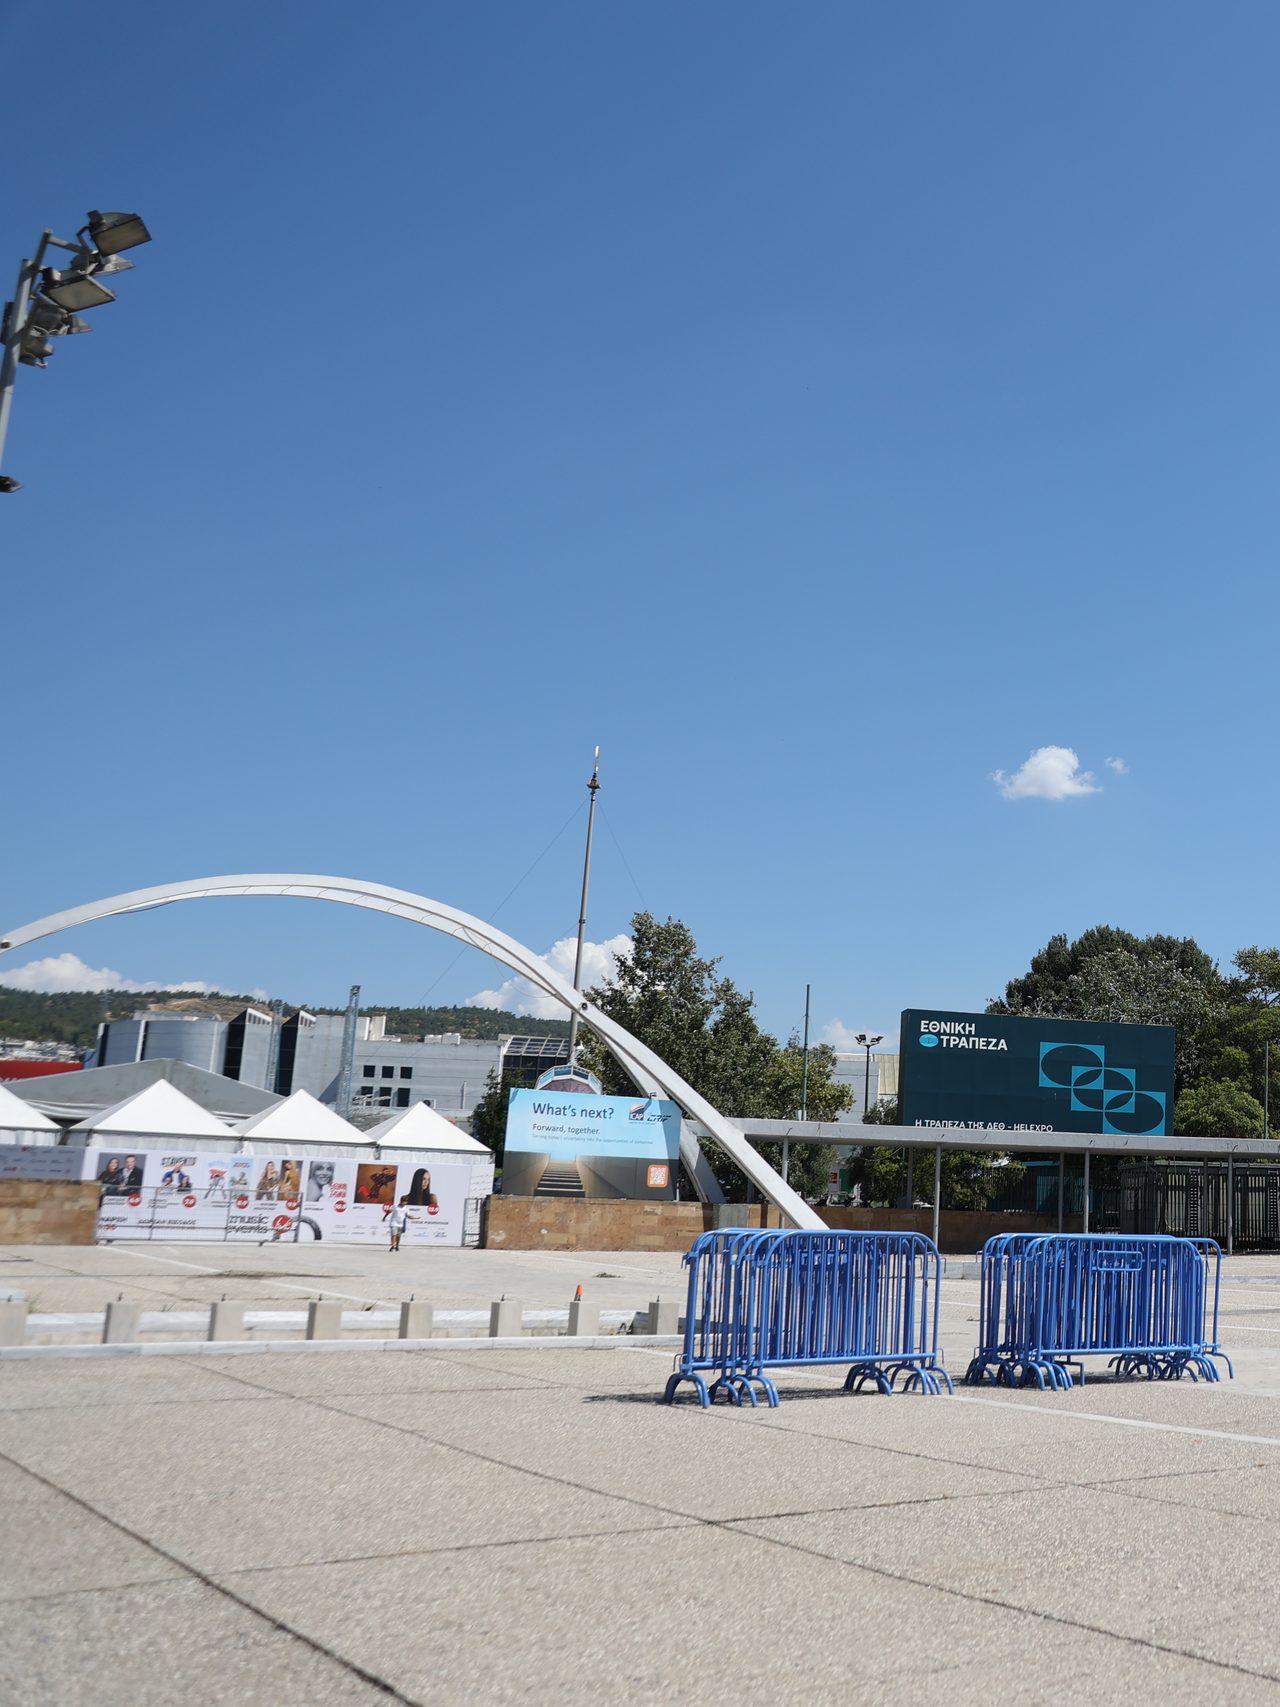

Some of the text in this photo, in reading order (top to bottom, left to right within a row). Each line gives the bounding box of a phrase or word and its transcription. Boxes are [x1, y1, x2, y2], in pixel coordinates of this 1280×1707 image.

[920, 1020, 976, 1035] ΕΘΝΙΚΗ
[940, 1035, 1008, 1051] ΤΡΑΠΕΖΑ
[580, 1107, 615, 1119] next?
[532, 1123, 601, 1136] Forward, together.
[915, 1119, 922, 1127] Η
[924, 1120, 965, 1129] ΤΡΑΠΕΖΑ
[968, 1121, 985, 1130] ΤΗΣ
[987, 1122, 1006, 1131] ΔΕΘ
[1014, 1124, 1053, 1132] HELEXPO
